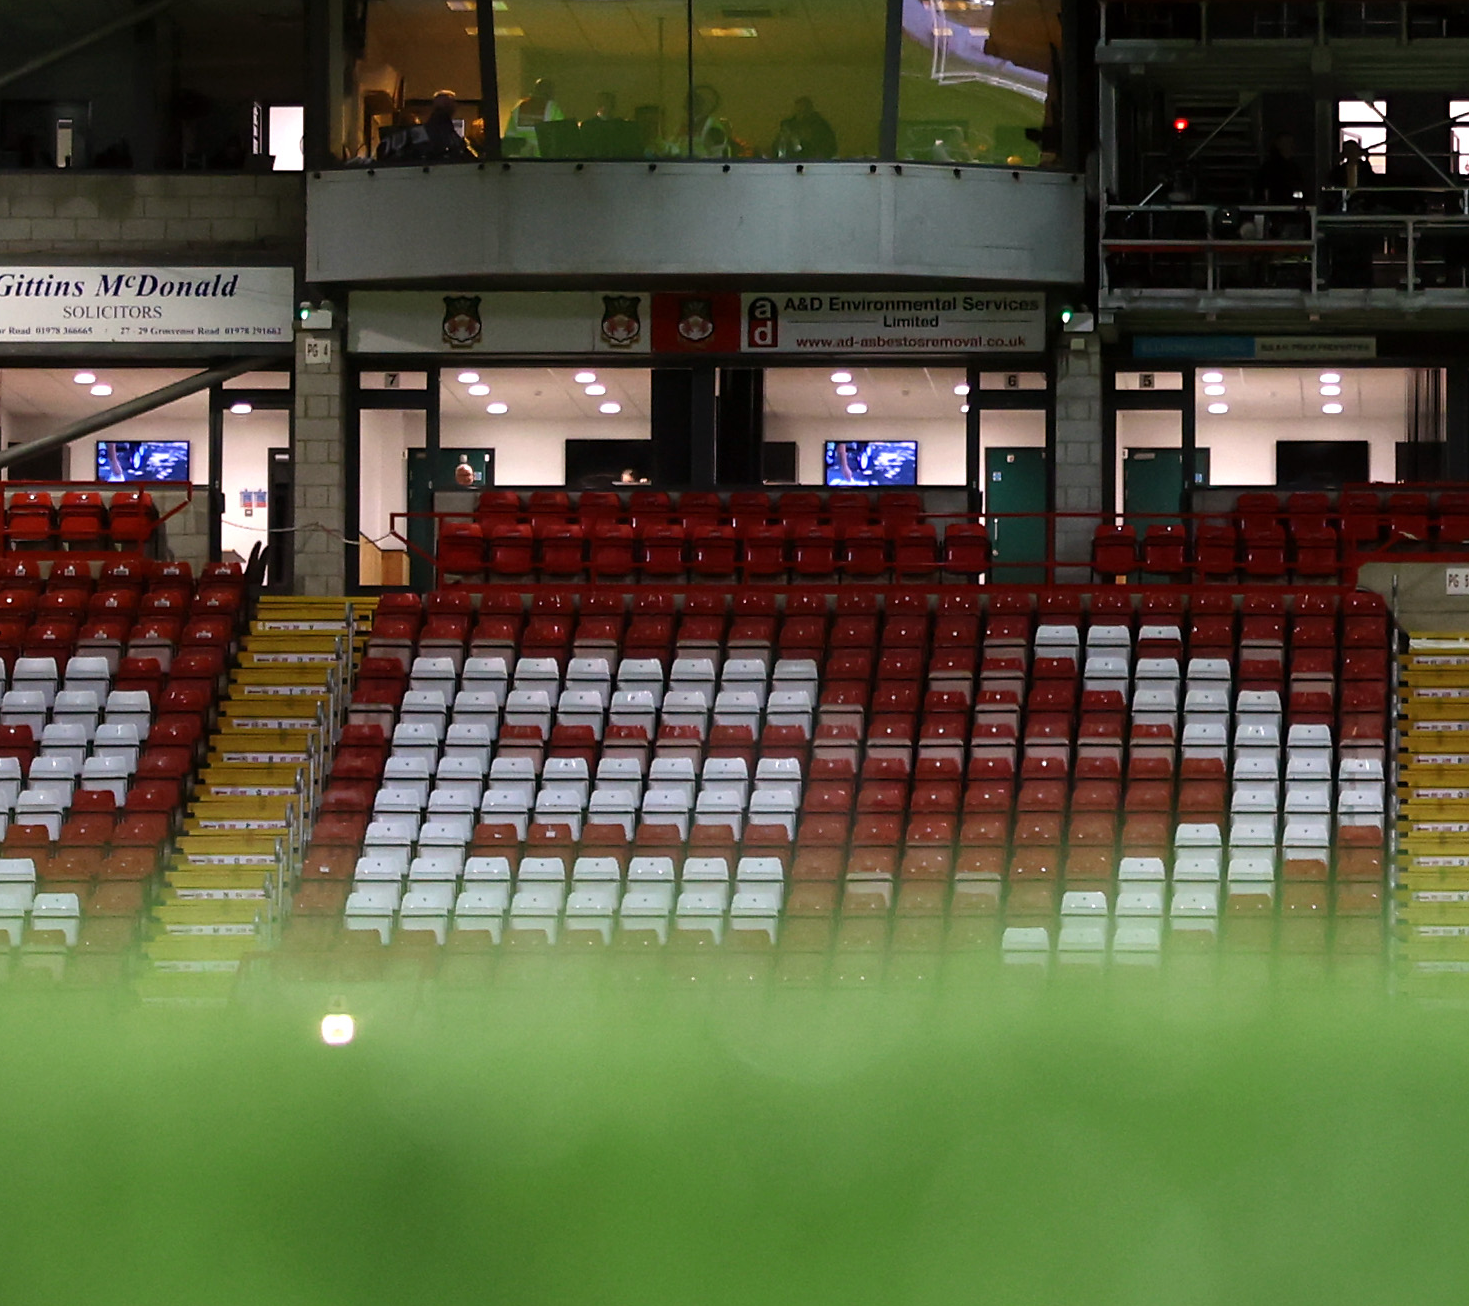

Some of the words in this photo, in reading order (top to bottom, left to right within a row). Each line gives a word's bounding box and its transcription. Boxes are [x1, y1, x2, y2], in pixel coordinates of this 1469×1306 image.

[784, 297, 823, 312] A&D
[829, 296, 957, 312] Environmental
[962, 296, 1039, 312] Services
[63, 305, 162, 319] SOLICITORS
[883, 314, 939, 328] Limited
[8, 326, 31, 335] Road
[197, 327, 220, 335] Road
[307, 344, 319, 357] PG
[389, 374, 397, 386] 7
[1009, 375, 1017, 387] 6
[1143, 375, 1152, 387] 5
[1448, 574, 1459, 587] PG
